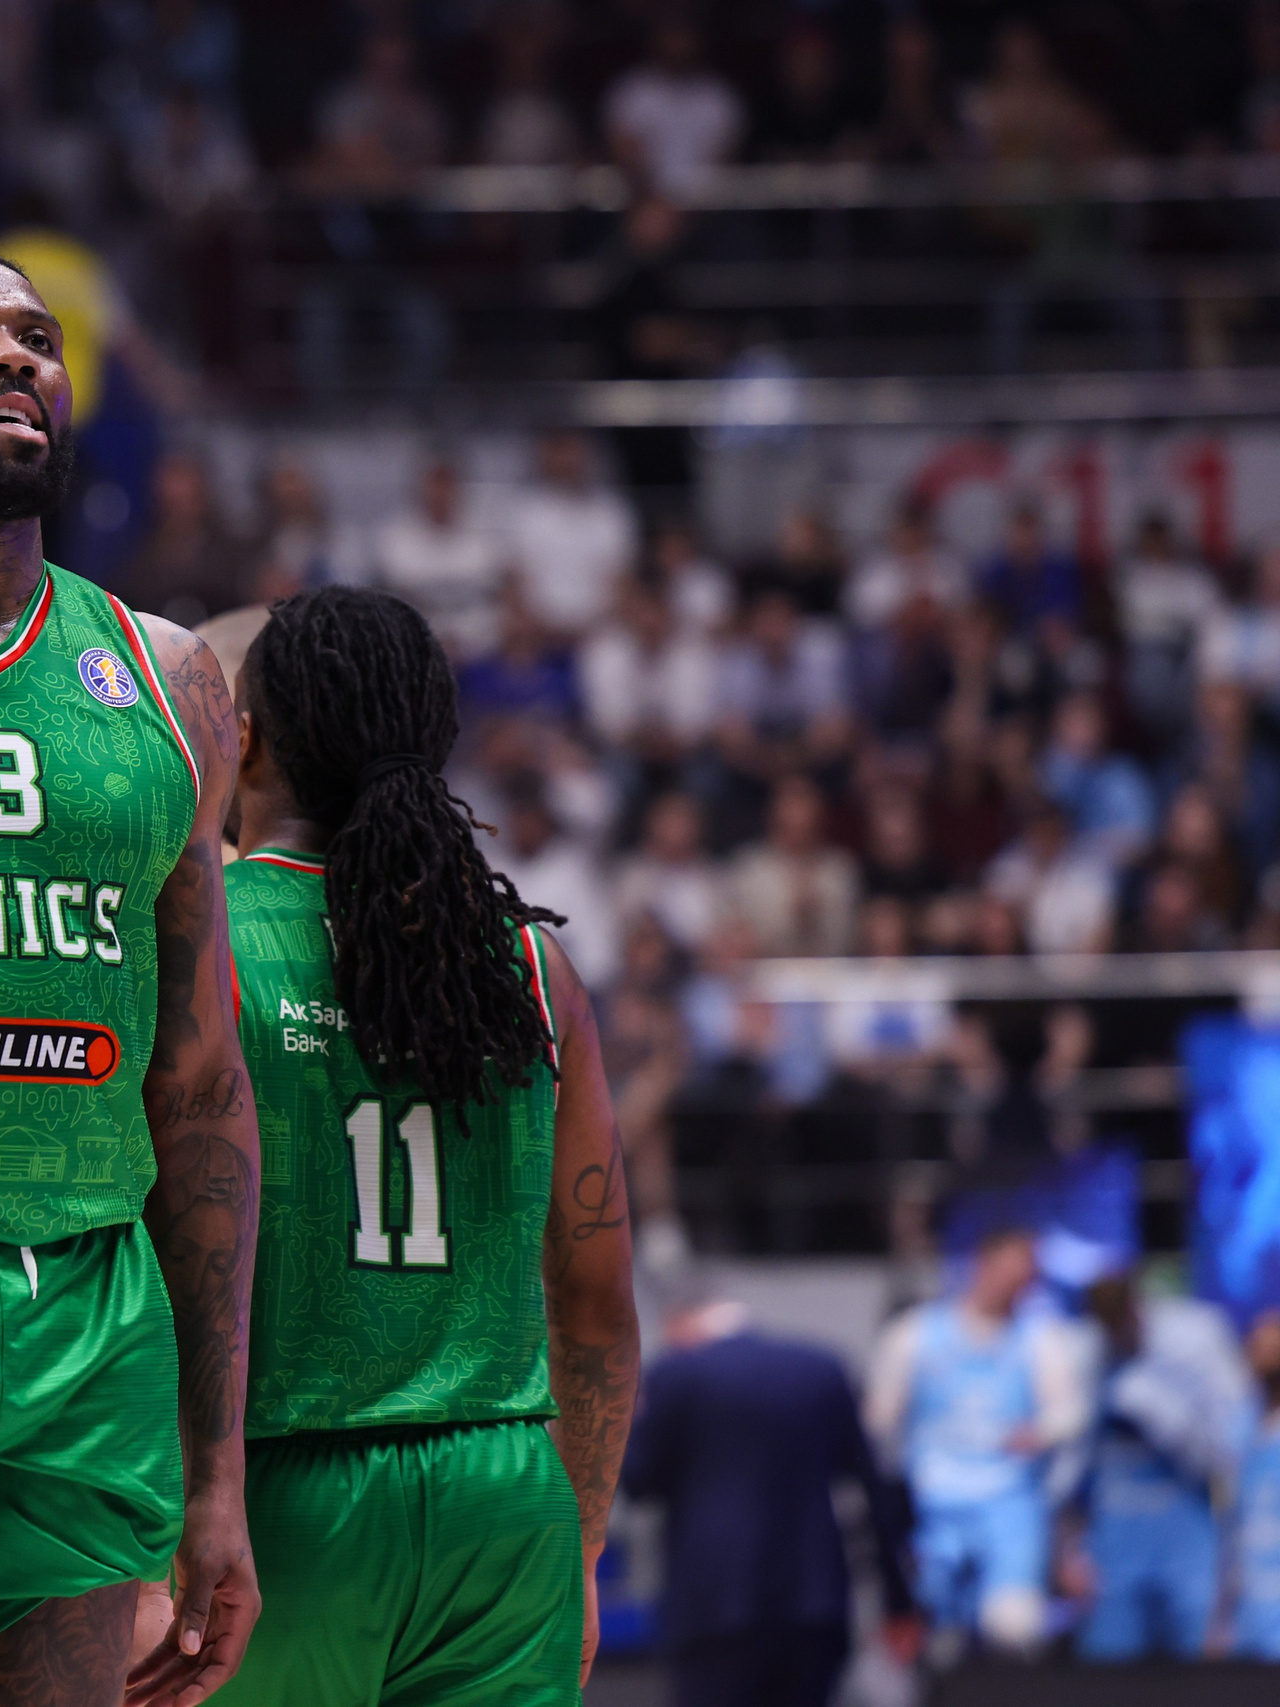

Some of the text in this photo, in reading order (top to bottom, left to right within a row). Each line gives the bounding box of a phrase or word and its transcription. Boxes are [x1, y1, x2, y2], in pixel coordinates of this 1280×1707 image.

[280, 998, 349, 1032] Ак Бар
[283, 1027, 330, 1057] Банк
[344, 1093, 453, 1272] 11
